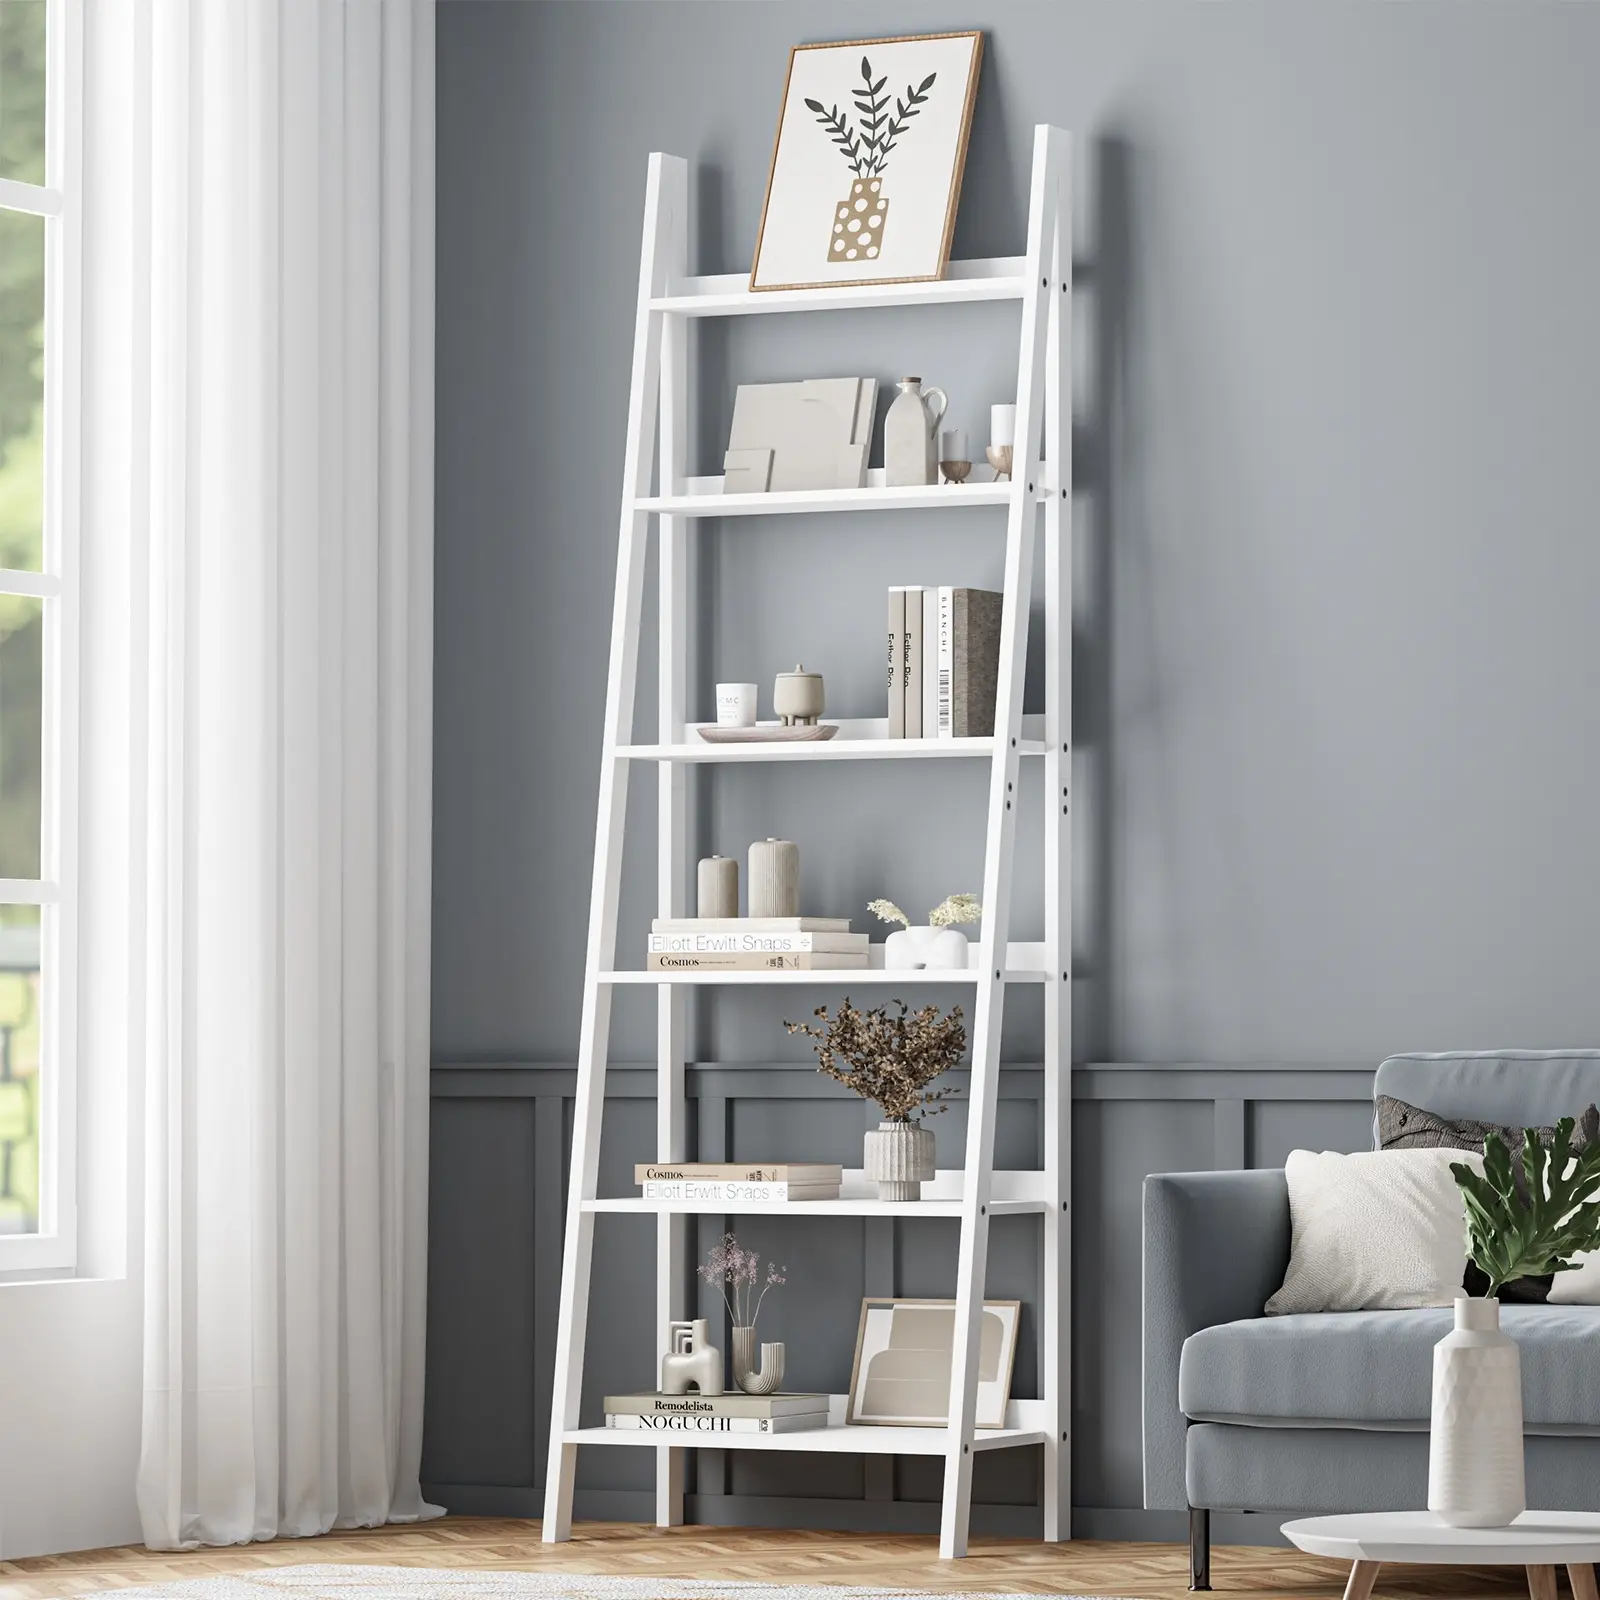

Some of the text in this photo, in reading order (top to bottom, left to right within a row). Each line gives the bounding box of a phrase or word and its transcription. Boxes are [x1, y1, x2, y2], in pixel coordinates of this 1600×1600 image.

[652, 935, 792, 953] Elliott Erwitt Snaps
[660, 956, 700, 967] Cosmos
[646, 1168, 684, 1179] Cosmos
[646, 1183, 770, 1201] Elliott Erwitt Snaps
[654, 1400, 714, 1412] Remodelista
[639, 1415, 731, 1431] NOGUCHI
